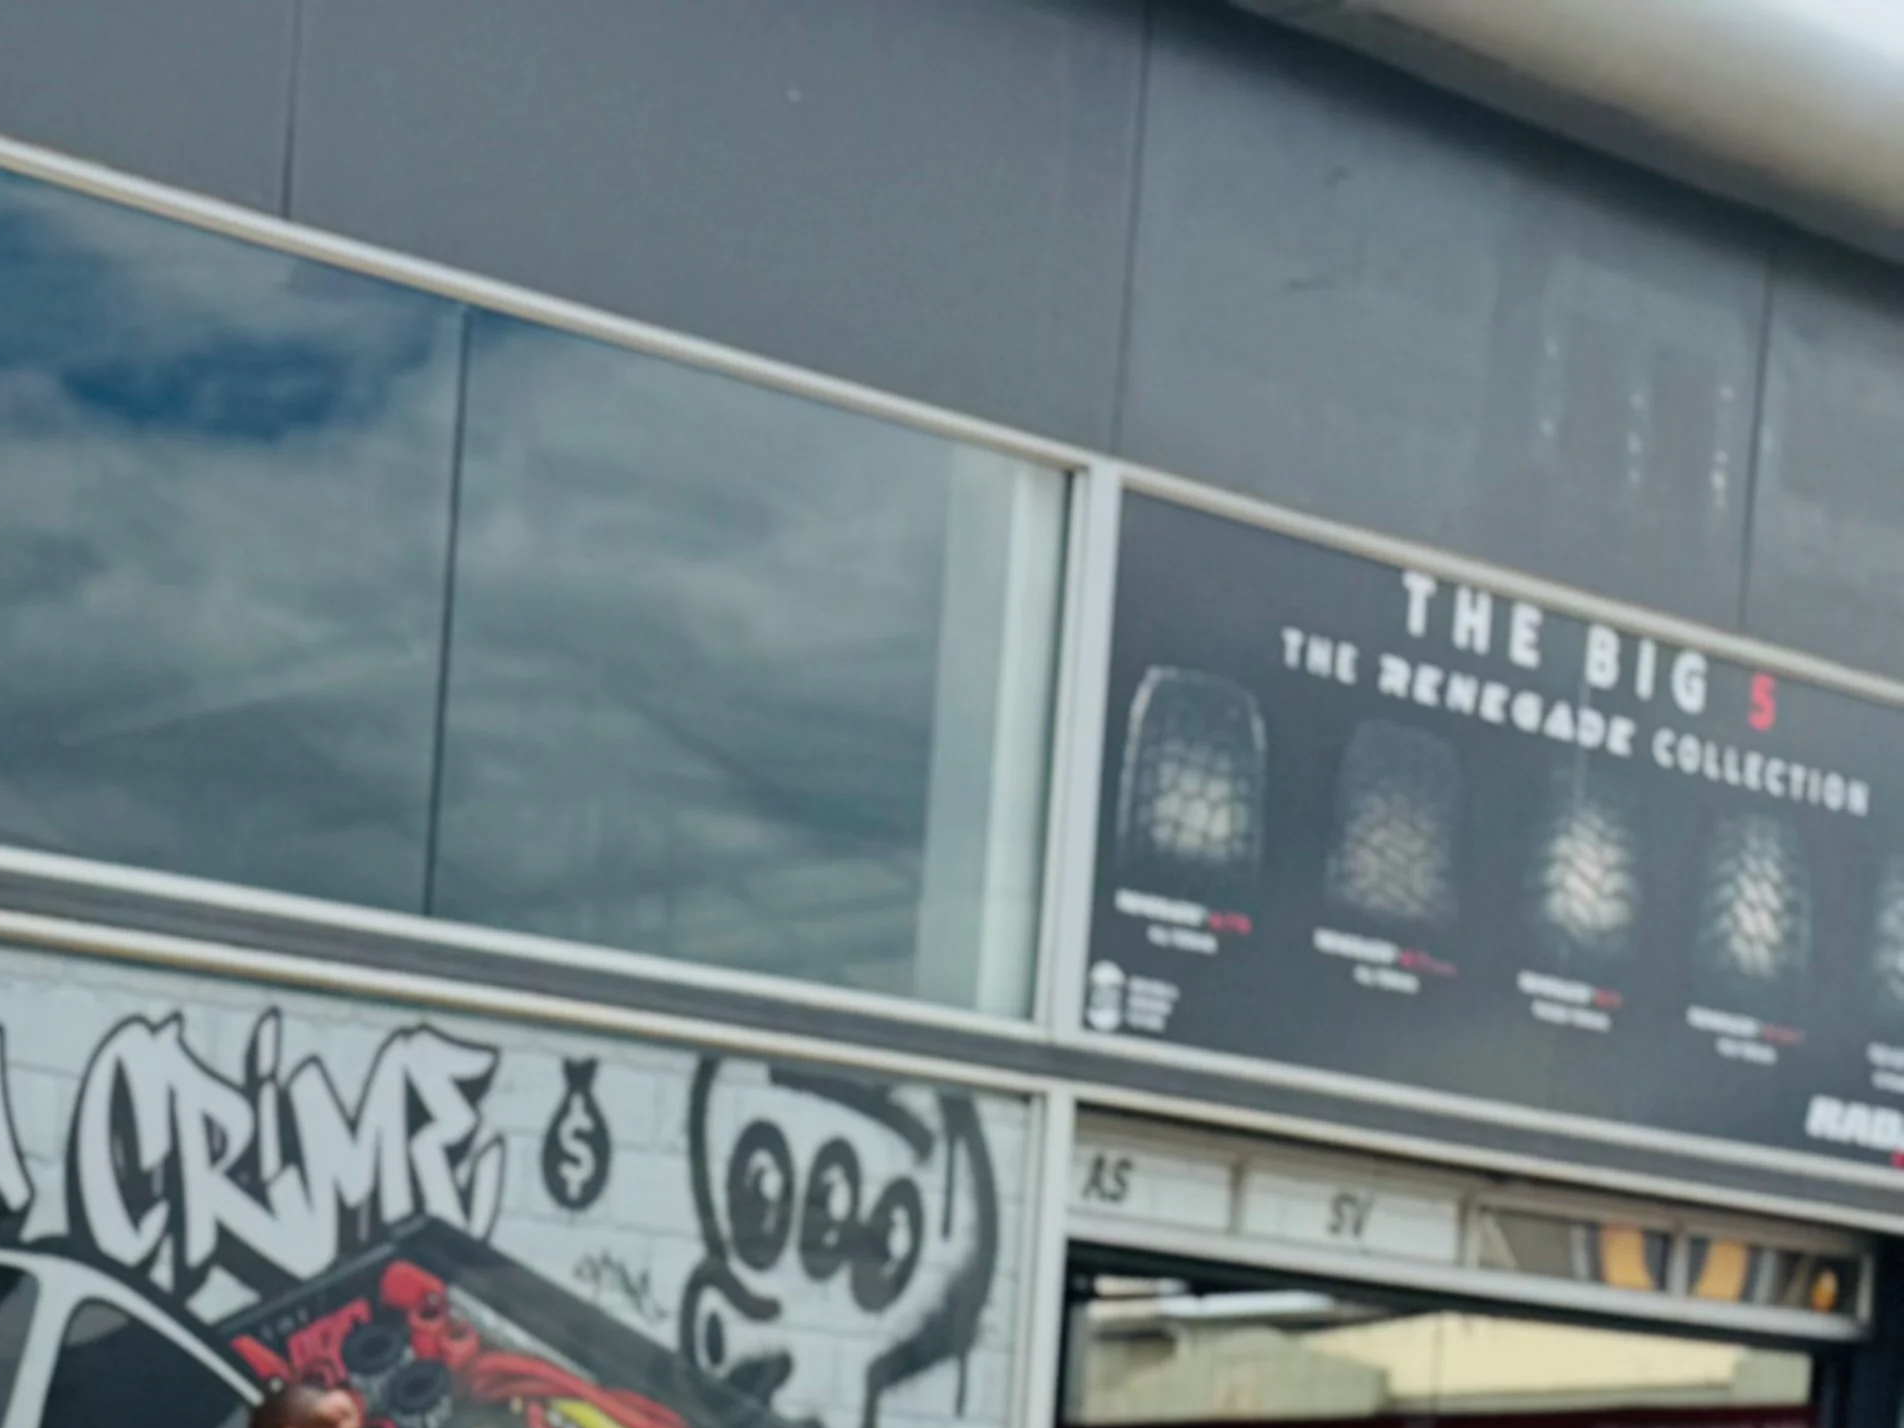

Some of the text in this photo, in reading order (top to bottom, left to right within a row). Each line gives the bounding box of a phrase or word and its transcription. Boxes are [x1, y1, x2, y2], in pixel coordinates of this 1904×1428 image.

[1282, 628, 1869, 817] THE RENEGADE COLLECTION
[1404, 571, 1777, 731] THE BIG 5
